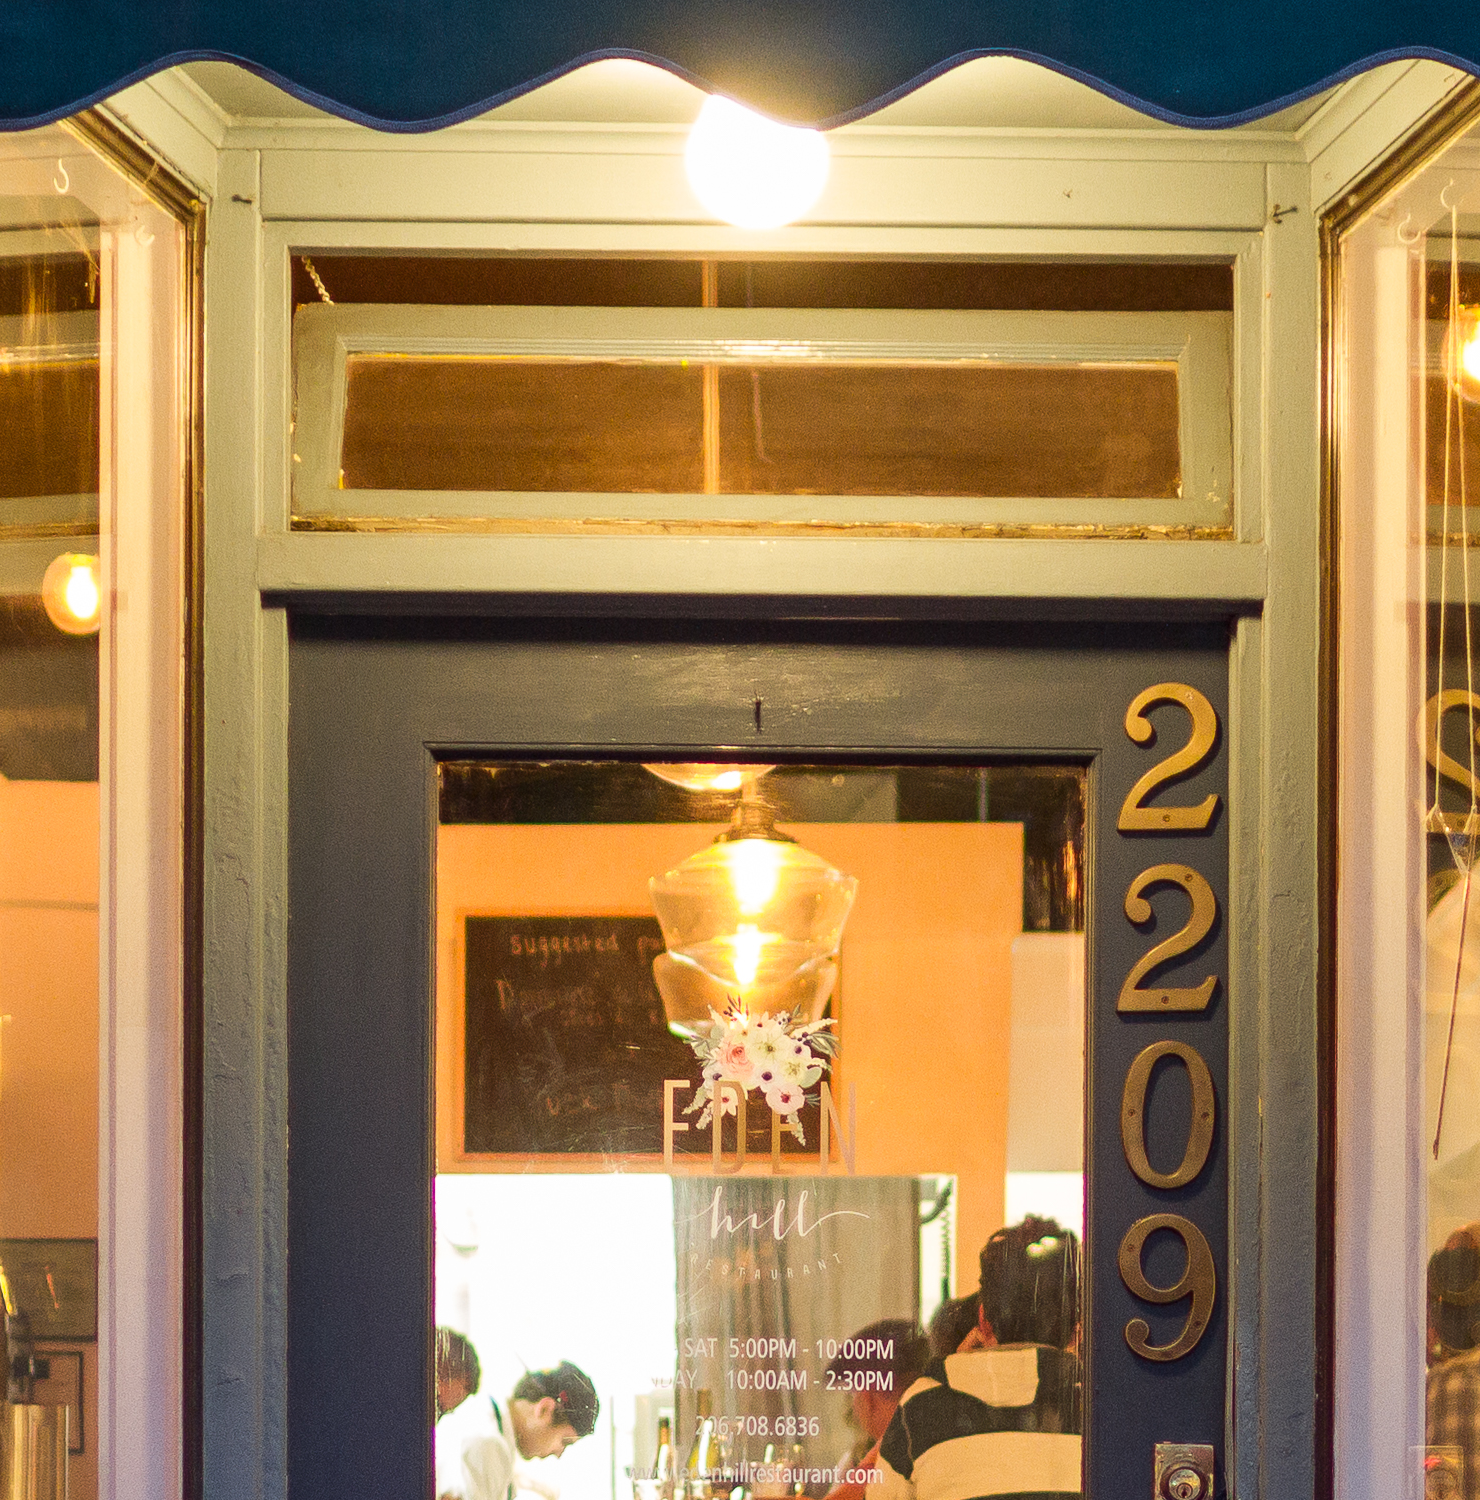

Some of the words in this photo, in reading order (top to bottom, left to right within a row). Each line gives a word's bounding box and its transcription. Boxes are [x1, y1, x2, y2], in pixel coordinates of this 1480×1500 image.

[1116, 682, 1219, 1363] 2209
[663, 1079, 857, 1176] EDEN
[674, 1186, 871, 1241] hill
[690, 1252, 843, 1281] RESTAURANT
[729, 1338, 797, 1359] 5:00PM
[816, 1339, 894, 1360] 10:00PM
[727, 1370, 808, 1391] 10:00AM
[826, 1370, 894, 1391] 2:30PM
